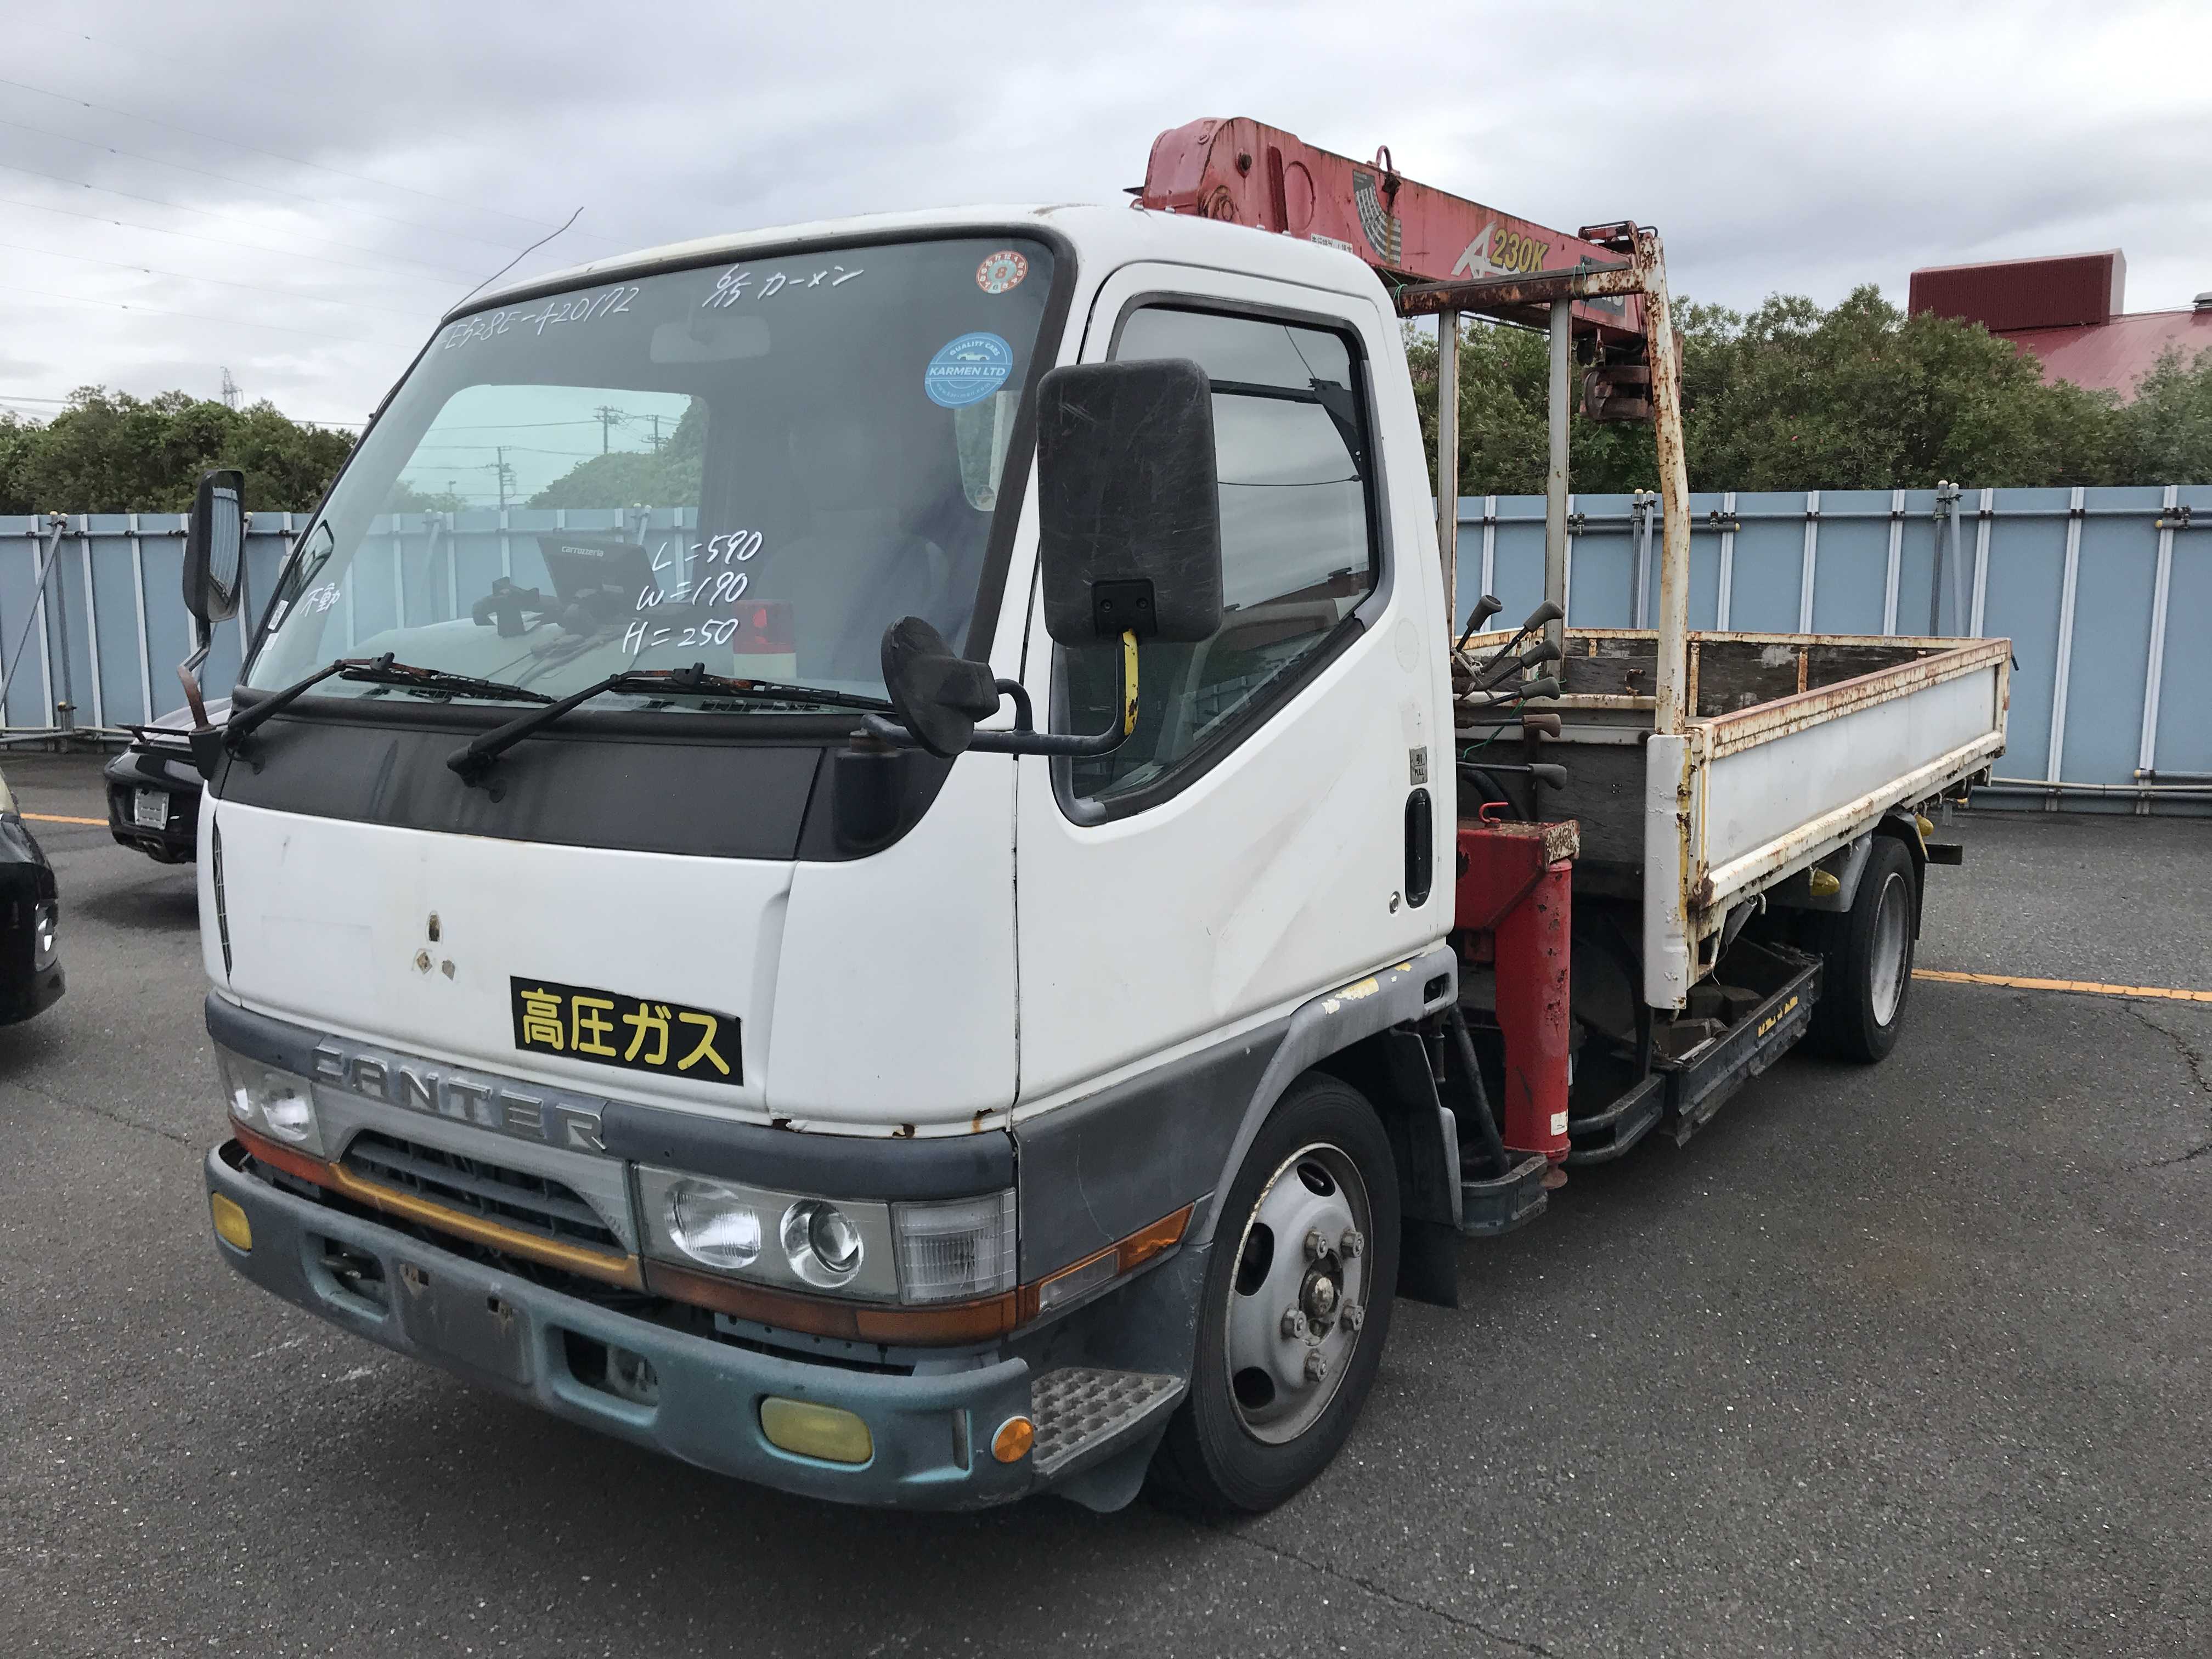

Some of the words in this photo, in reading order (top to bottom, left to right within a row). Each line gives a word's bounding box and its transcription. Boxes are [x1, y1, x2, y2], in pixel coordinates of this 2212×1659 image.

[950, 340, 984, 356] QUALITY
[985, 342, 1001, 357] CARS
[929, 366, 981, 376] KARMEN
[983, 367, 1006, 376] LTD
[561, 546, 604, 557] carrozzeria
[1414, 768, 1424, 776] PULL
[520, 988, 731, 1075] 高圧ガス
[313, 1043, 607, 1151] CANTER
